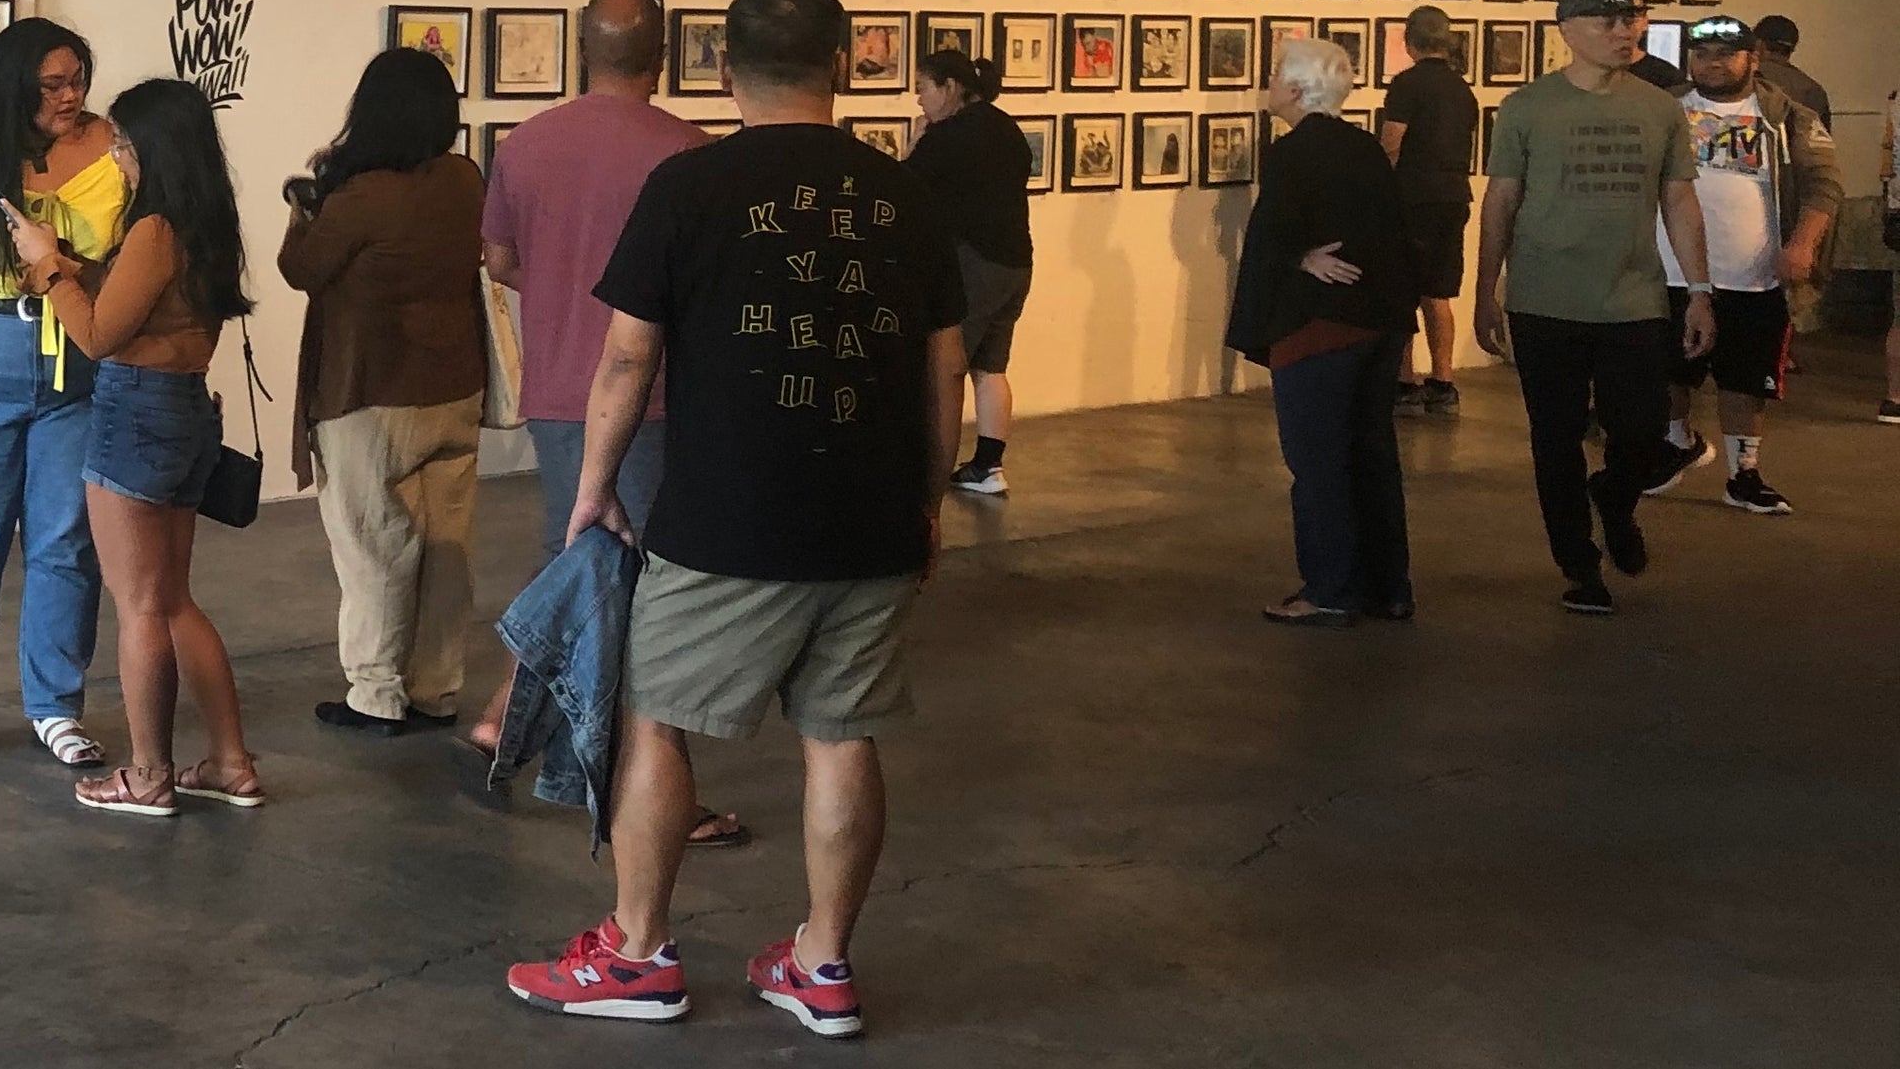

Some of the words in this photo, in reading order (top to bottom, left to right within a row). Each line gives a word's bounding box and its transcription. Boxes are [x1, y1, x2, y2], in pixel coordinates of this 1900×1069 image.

[168, 0, 254, 80] WOW!
[195, 49, 250, 103] WAI'I
[748, 184, 896, 240] KEEP
[786, 250, 866, 293] YA
[740, 304, 901, 360] HEAD
[780, 374, 858, 423] UP
